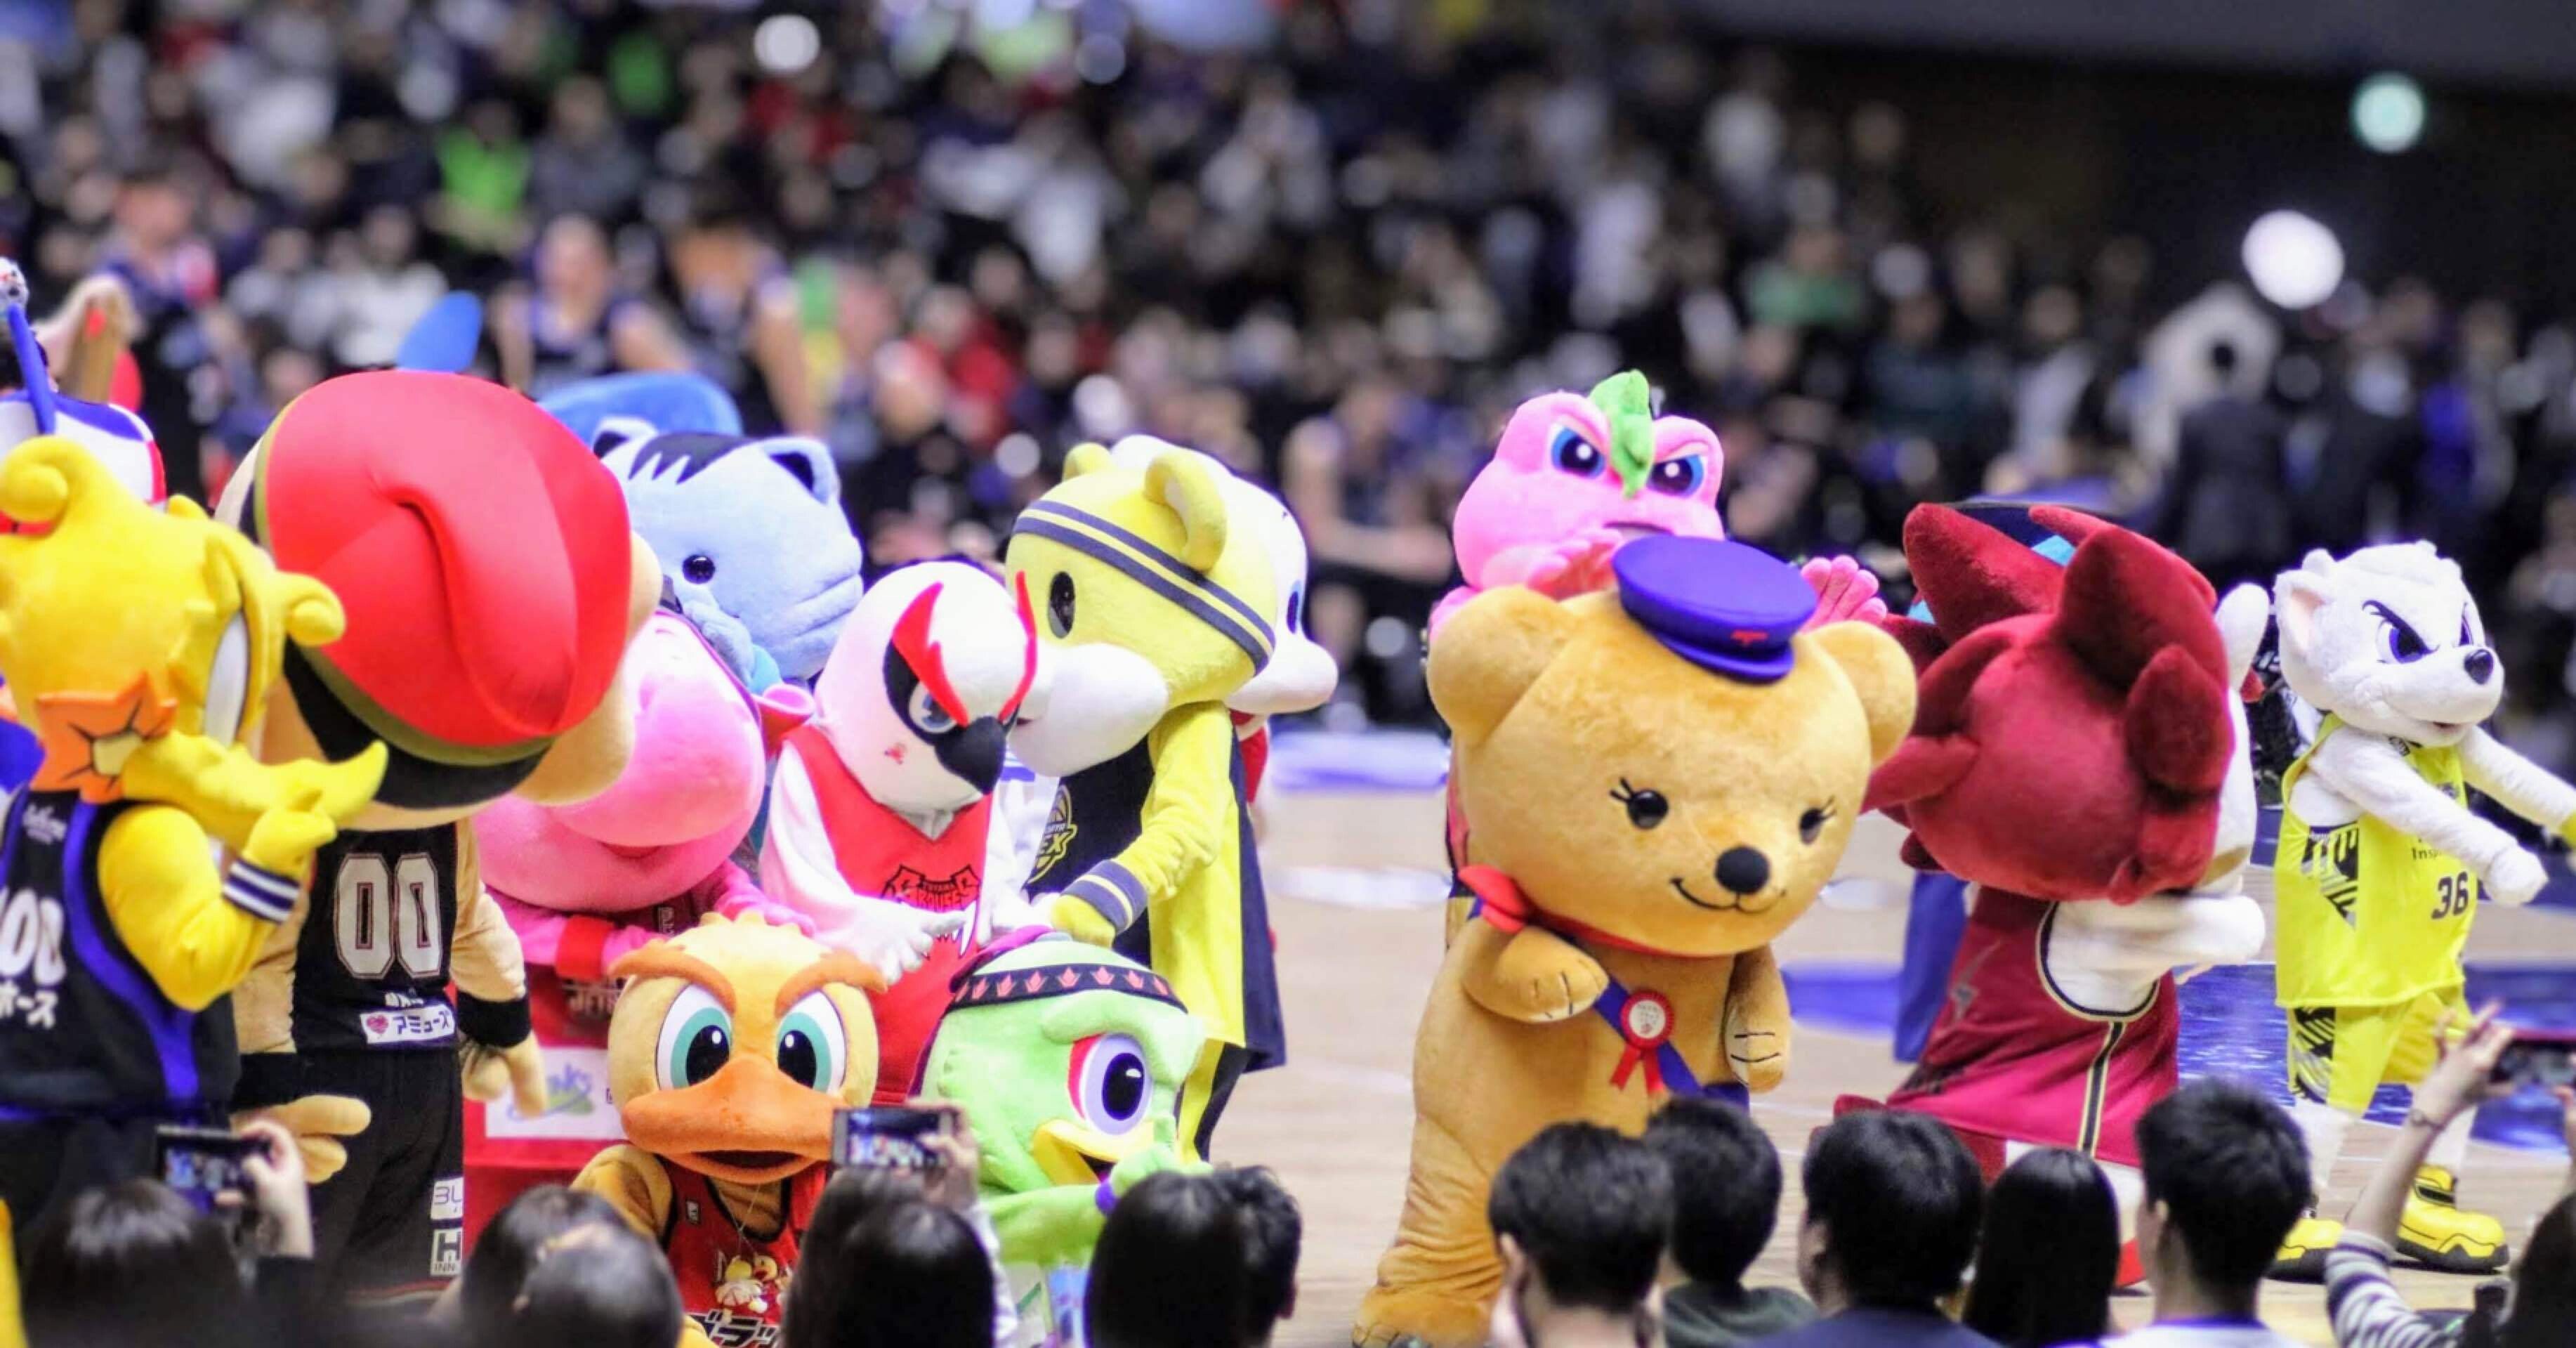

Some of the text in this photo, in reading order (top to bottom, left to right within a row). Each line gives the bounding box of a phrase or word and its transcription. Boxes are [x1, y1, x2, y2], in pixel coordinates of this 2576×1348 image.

[333, 853, 442, 979] 00
[2431, 871, 2468, 920] 36
[392, 1009, 451, 1035] アミューズ
